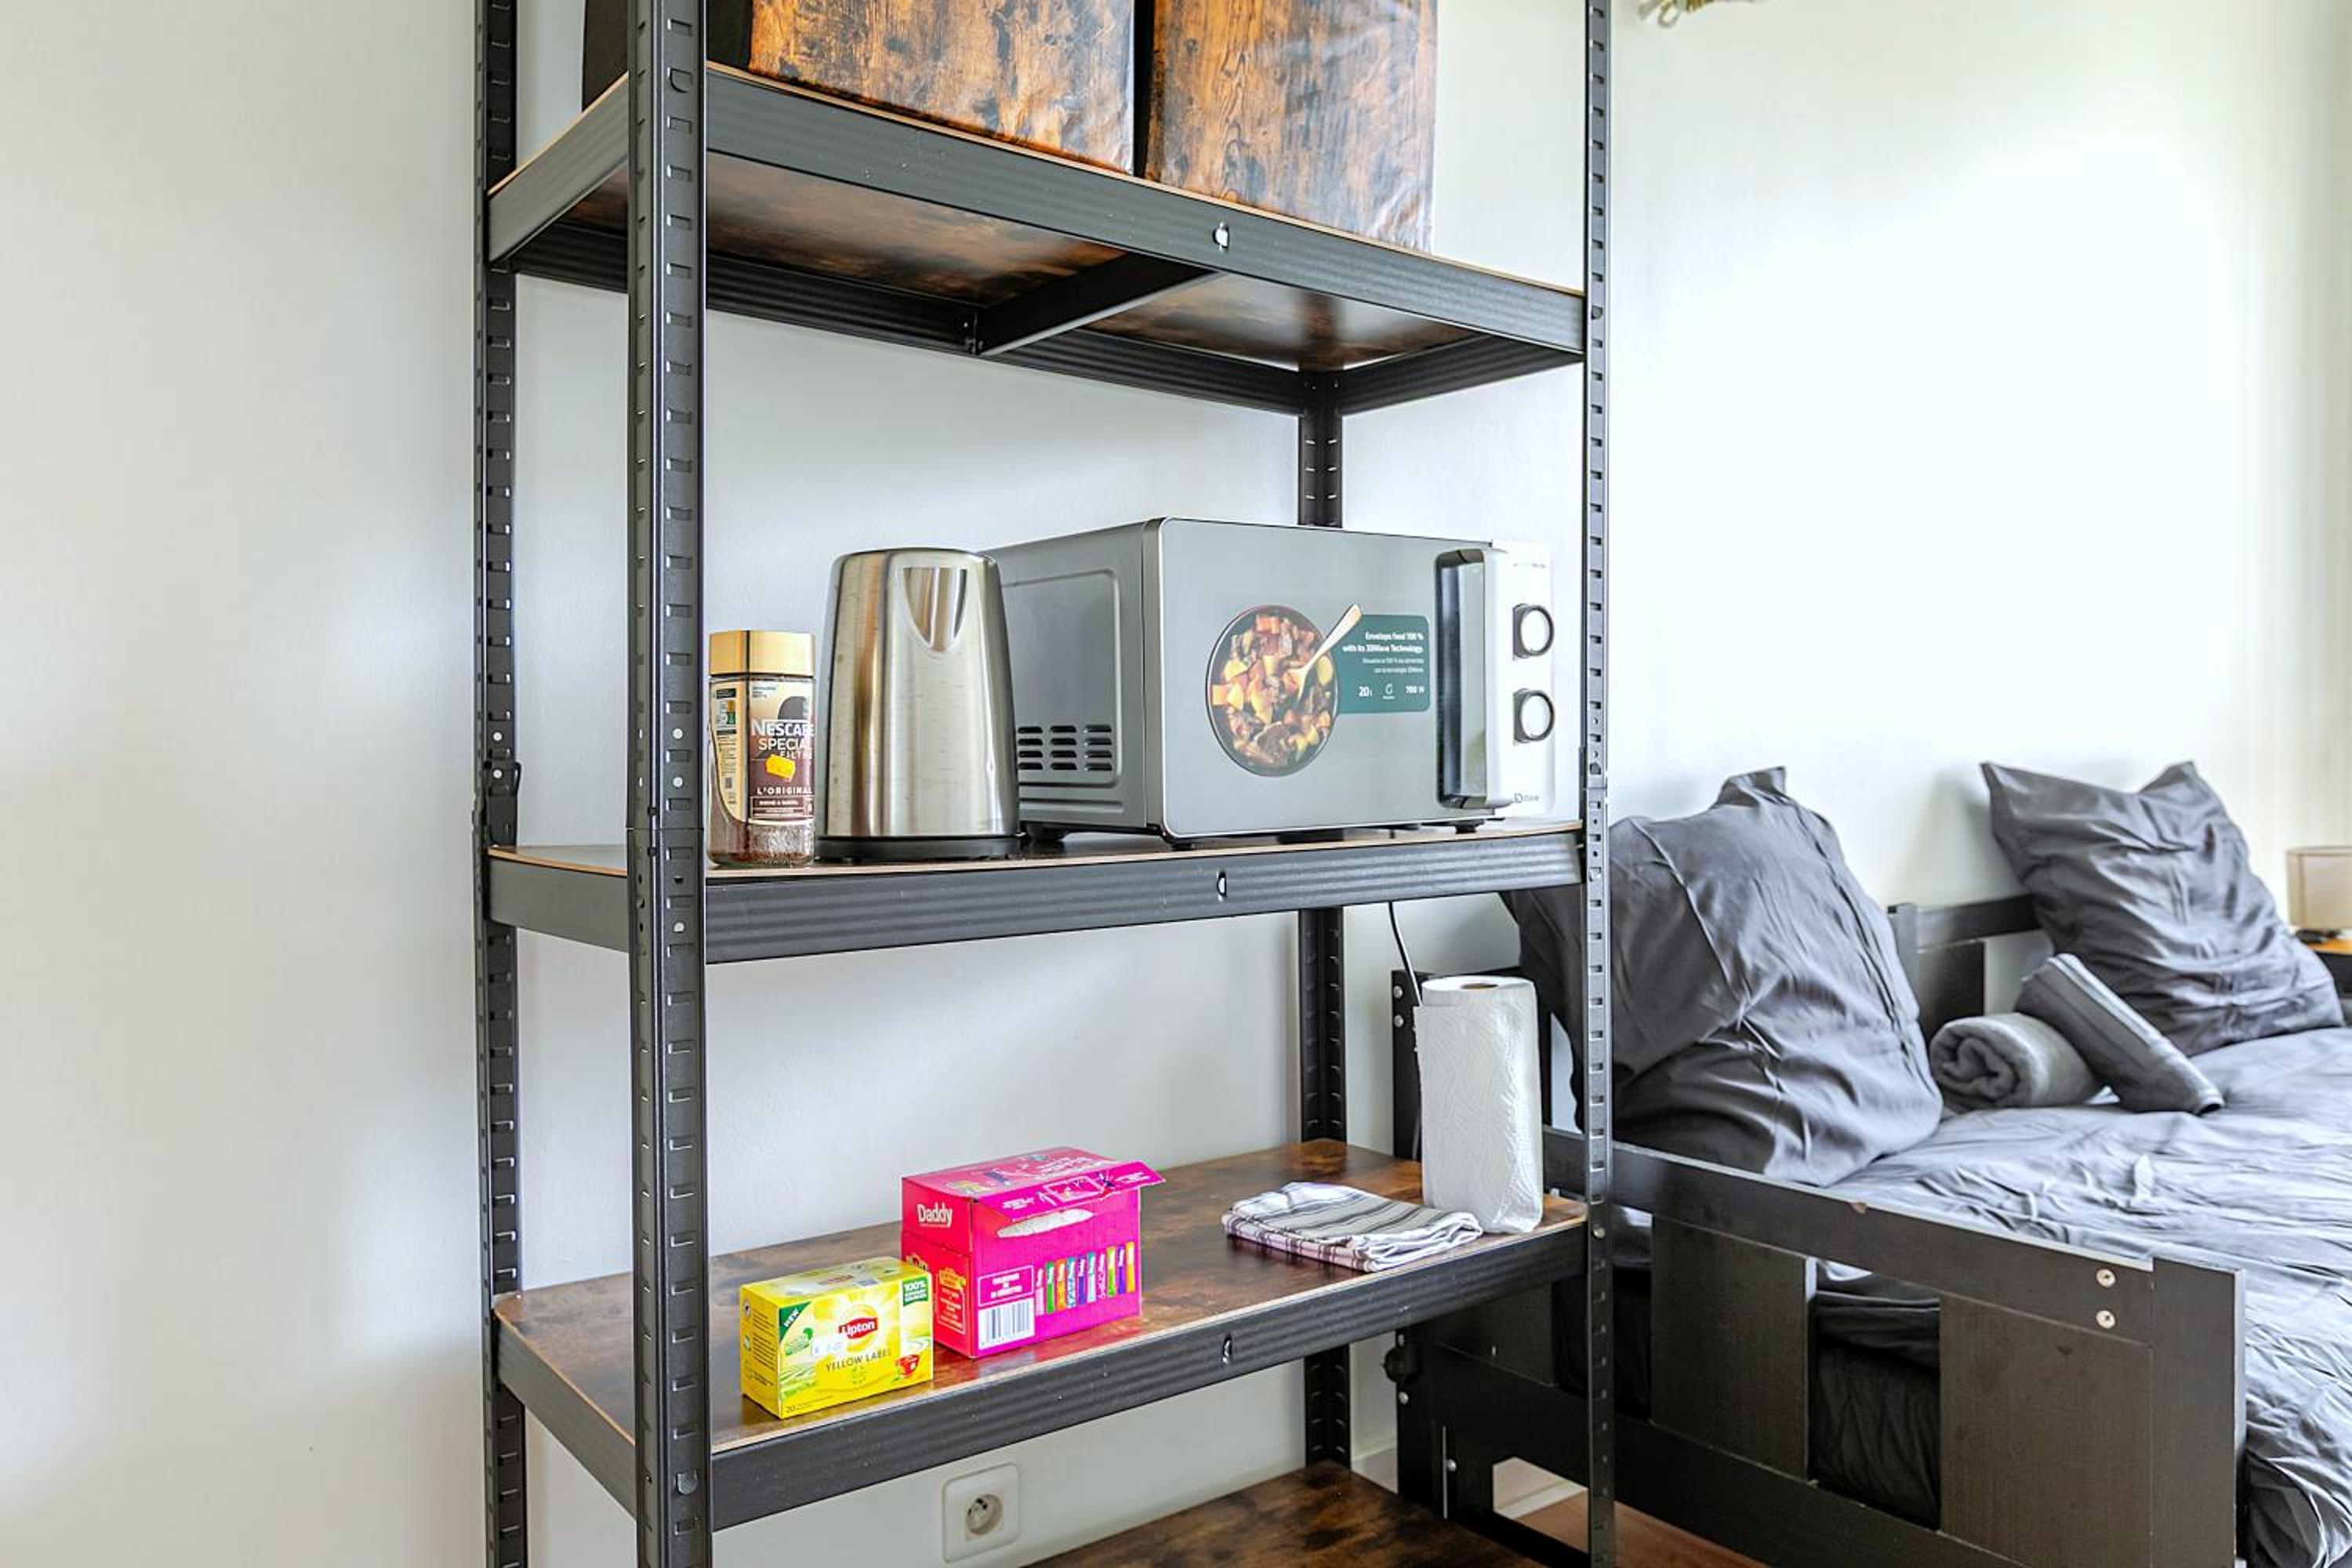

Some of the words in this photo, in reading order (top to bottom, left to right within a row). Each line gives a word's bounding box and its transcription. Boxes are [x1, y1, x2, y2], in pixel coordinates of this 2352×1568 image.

[1392, 632, 1405, 641] food
[756, 786, 814, 796] L'ORIGINAL
[916, 1201, 953, 1229] Daddy
[904, 1279, 926, 1293] 100%
[784, 1307, 799, 1327] NEW
[840, 1321, 876, 1337] Lipton
[826, 1355, 863, 1372] YELLOW
[865, 1348, 891, 1363] LABEL
